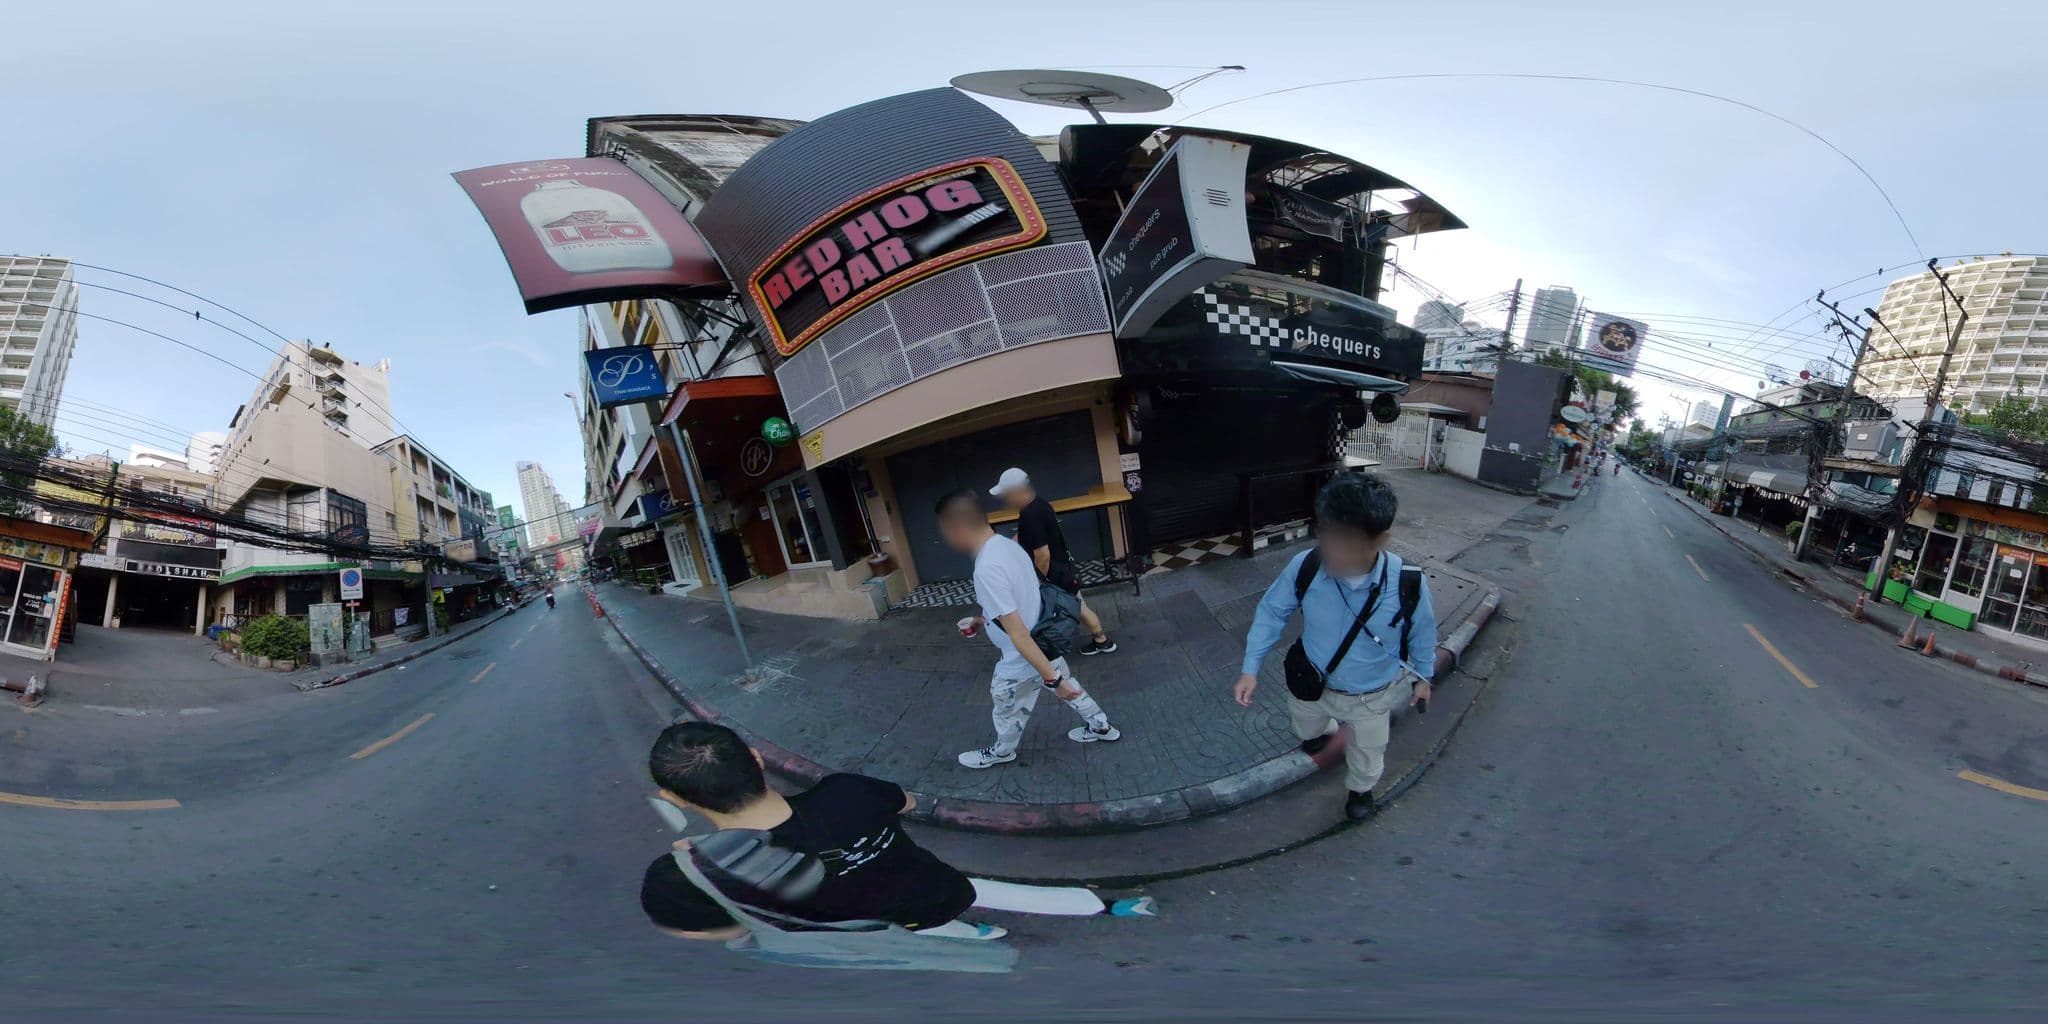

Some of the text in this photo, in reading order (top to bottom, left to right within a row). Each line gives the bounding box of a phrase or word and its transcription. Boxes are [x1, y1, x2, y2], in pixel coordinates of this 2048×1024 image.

[481, 175, 540, 187] WORLD
[547, 224, 651, 246] LEO
[763, 237, 841, 309] RED
[841, 180, 983, 251] HOG
[1128, 208, 1161, 251] chequers
[1150, 236, 1178, 270] pub grub
[819, 237, 913, 306] BAR
[1294, 325, 1381, 359] chequers
